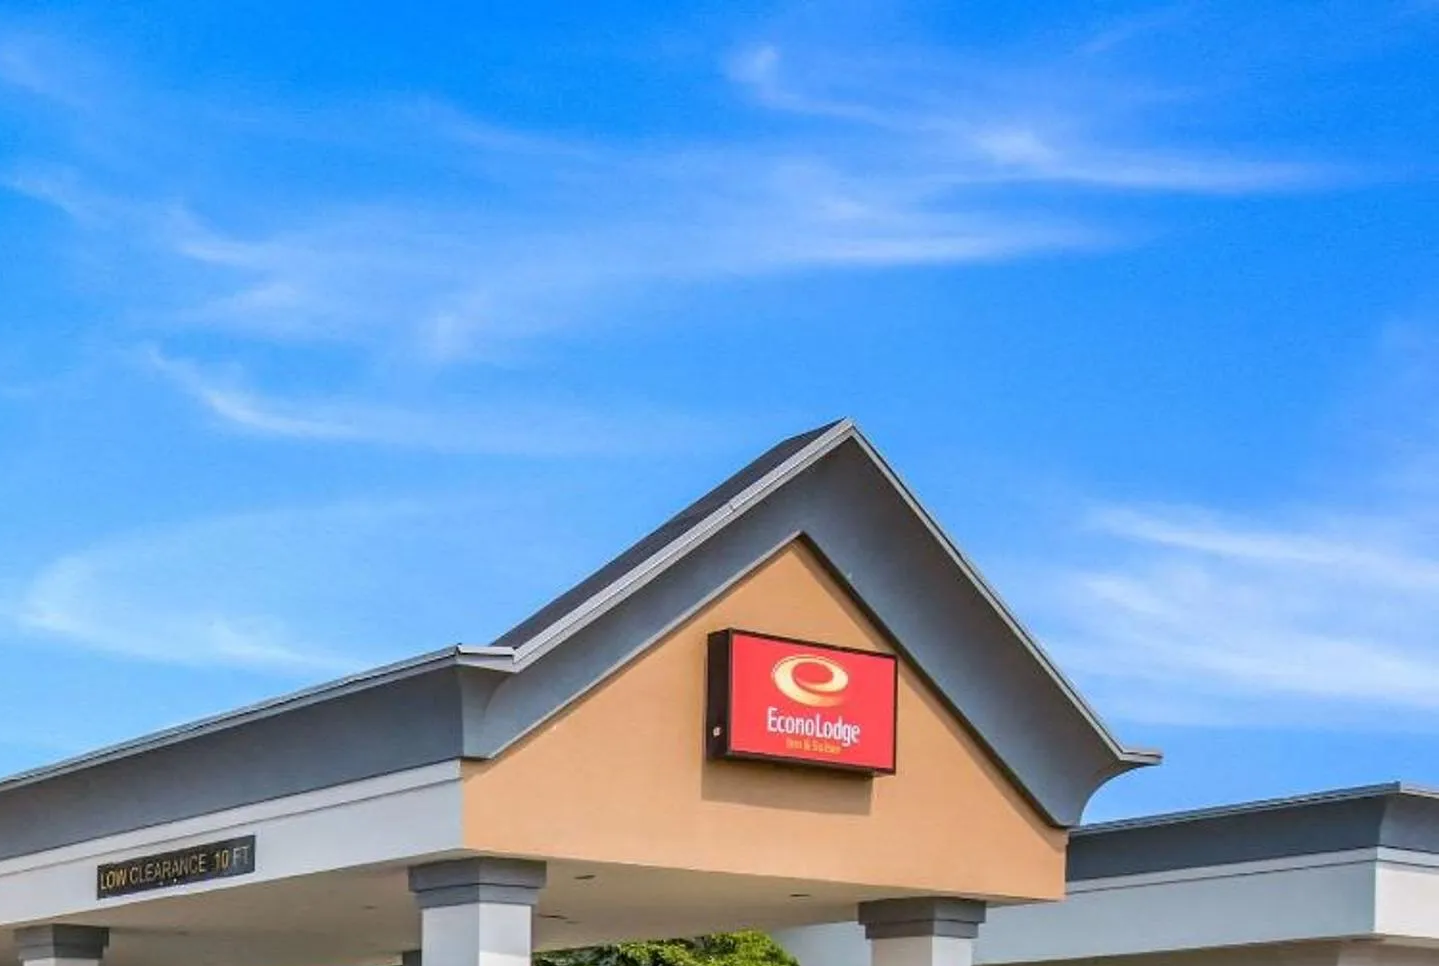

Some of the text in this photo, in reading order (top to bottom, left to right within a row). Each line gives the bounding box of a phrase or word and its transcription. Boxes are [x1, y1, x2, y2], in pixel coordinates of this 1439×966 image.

[767, 706, 860, 747] EconoLodge
[100, 846, 249, 890] LOW CLEARANCE 10 FT
